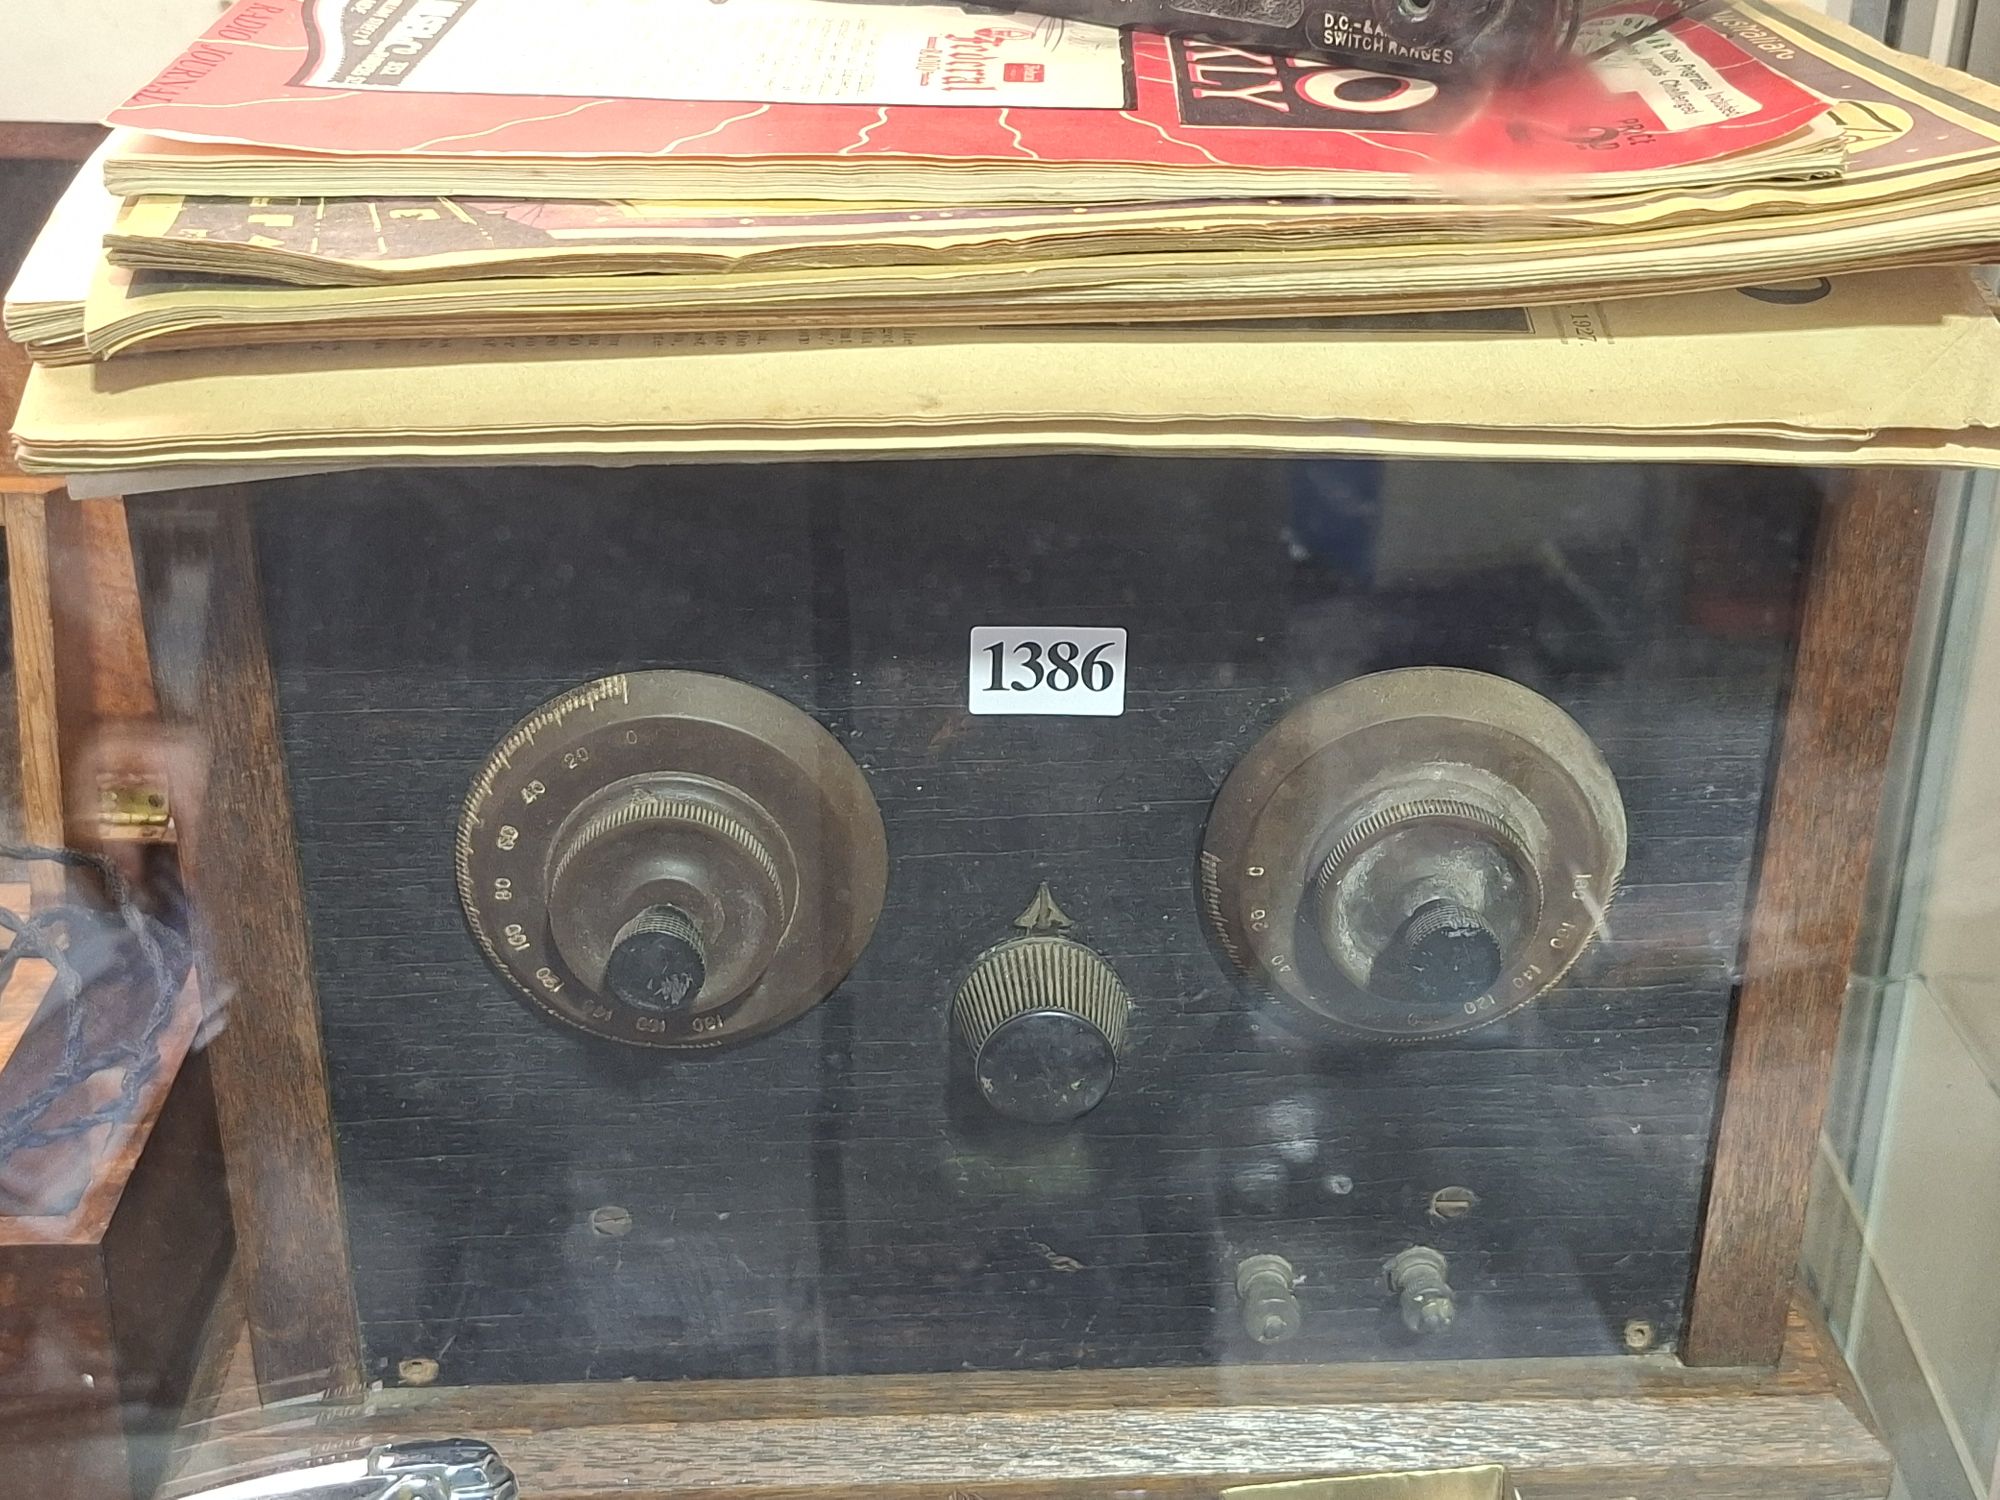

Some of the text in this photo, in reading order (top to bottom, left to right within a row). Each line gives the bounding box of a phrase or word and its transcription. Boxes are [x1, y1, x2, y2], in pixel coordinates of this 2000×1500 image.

[1323, 30, 1454, 65] SWITCH RANGES
[1711, 9, 1794, 61] ustralian
[132, 2, 285, 103] RADIO JOURNAL
[942, 33, 1004, 91] Federal
[982, 641, 1116, 692] 1386
[564, 747, 589, 770] 20
[520, 780, 546, 805] 40
[494, 877, 512, 900] 80
[504, 923, 531, 951] 100
[1463, 994, 1496, 1015] 120
